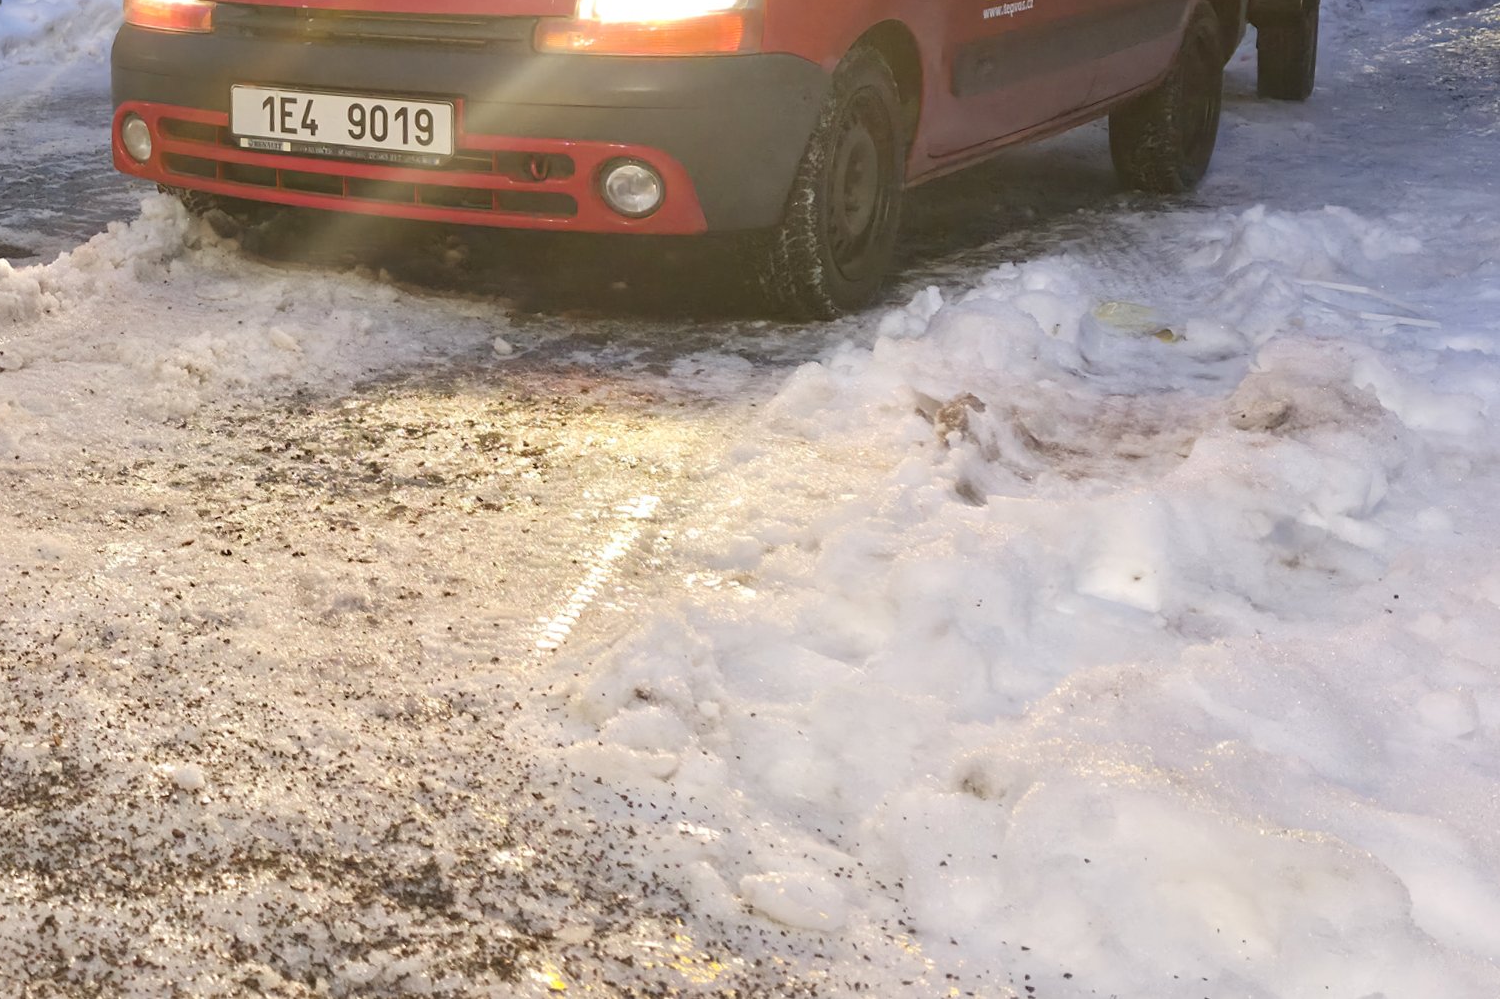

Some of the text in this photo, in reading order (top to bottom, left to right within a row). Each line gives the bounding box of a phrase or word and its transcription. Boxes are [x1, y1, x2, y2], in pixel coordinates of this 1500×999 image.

[983, 0, 1034, 19] www.tepvos.cz
[262, 96, 434, 146] 1E4 9019
